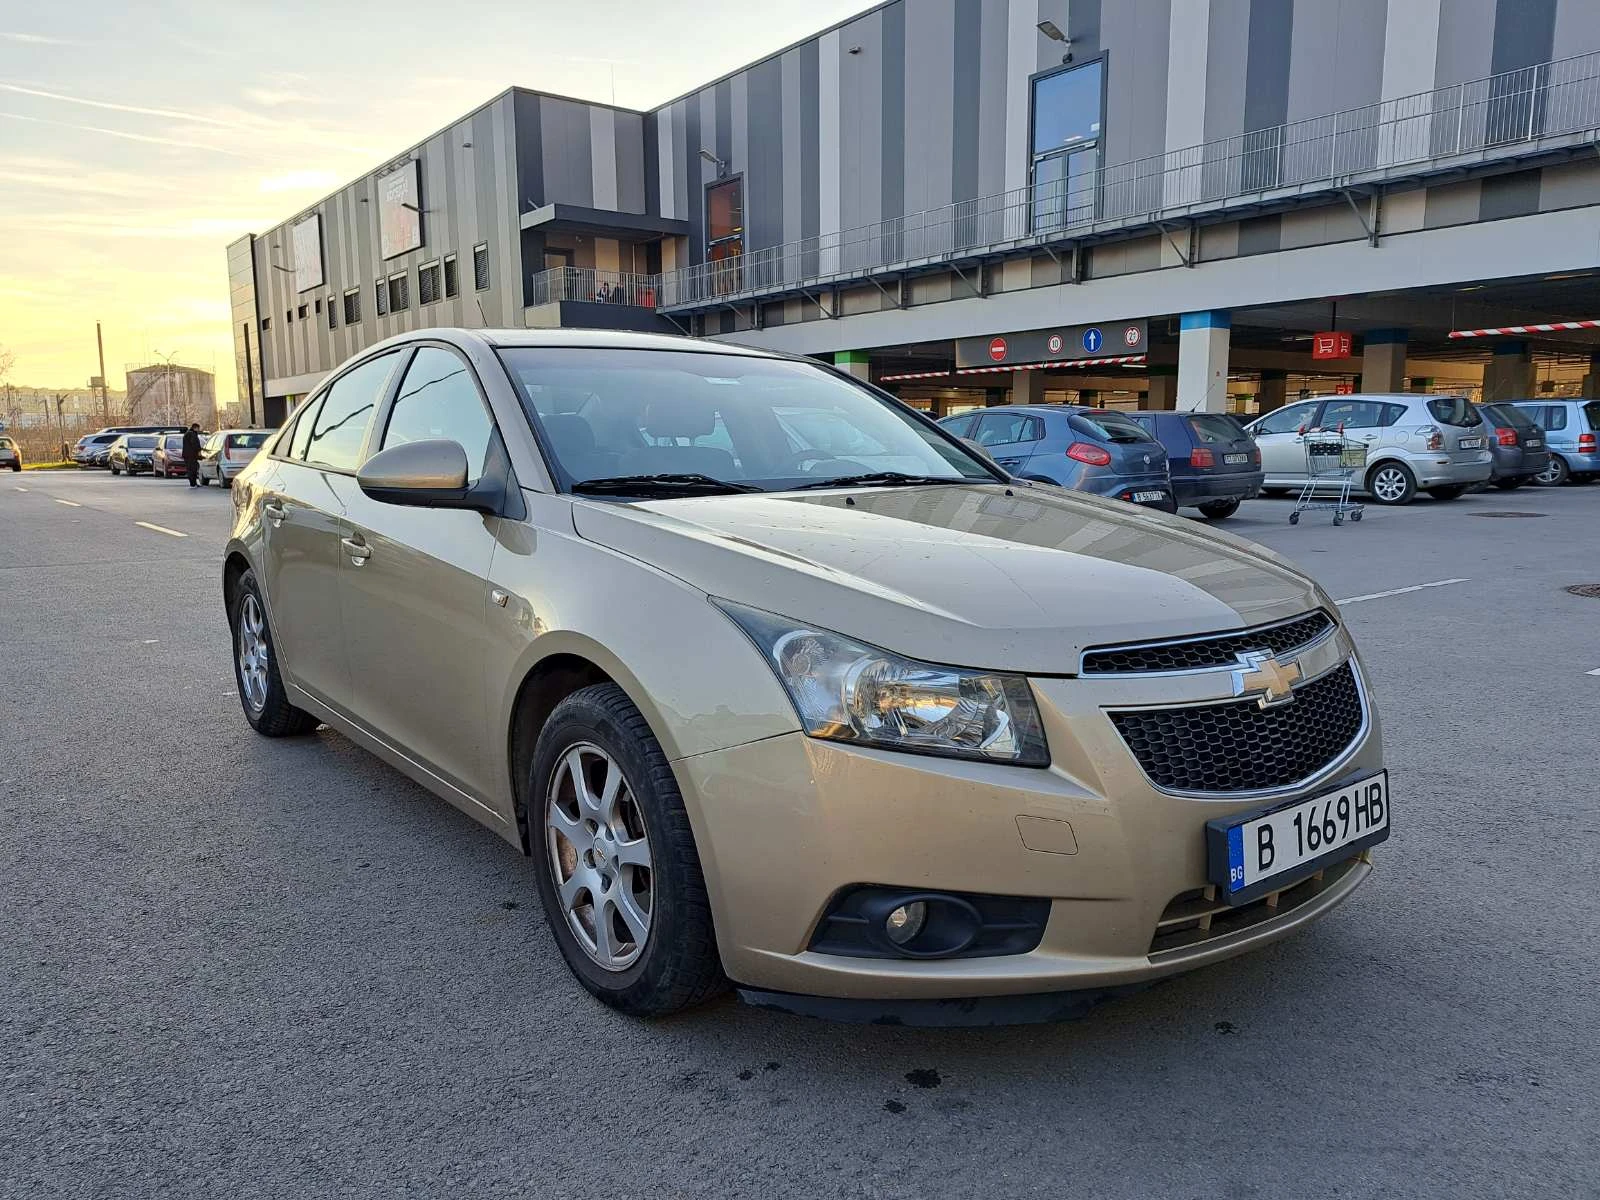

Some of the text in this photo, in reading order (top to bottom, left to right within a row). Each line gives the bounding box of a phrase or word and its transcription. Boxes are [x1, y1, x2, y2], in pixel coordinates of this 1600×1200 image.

[1052, 339, 1059, 349] 10
[1257, 823, 1275, 871] B
[1230, 865, 1243, 882] BG
